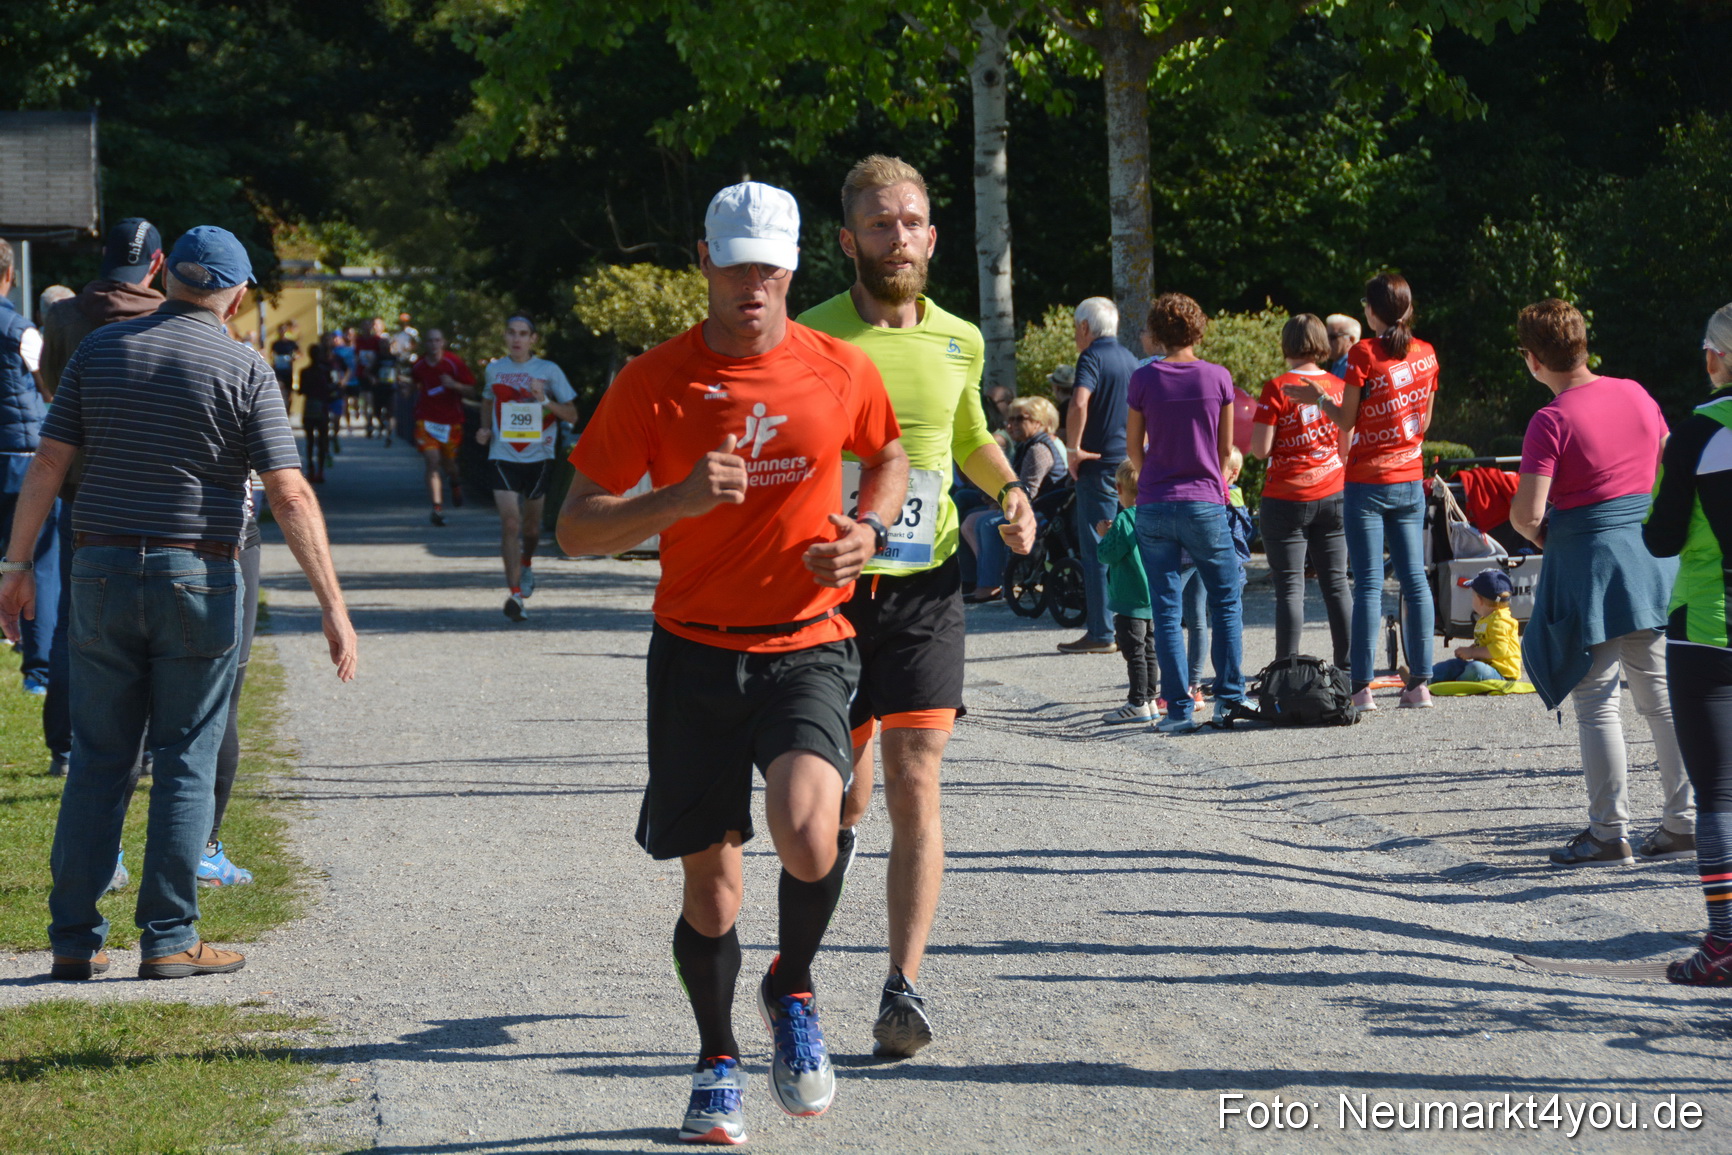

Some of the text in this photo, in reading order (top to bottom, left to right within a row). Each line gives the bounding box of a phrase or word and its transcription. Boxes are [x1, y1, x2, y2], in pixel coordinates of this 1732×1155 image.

[1363, 385, 1428, 418] aumbox
[511, 413, 533, 426] 299
[1275, 421, 1335, 448] aumbox
